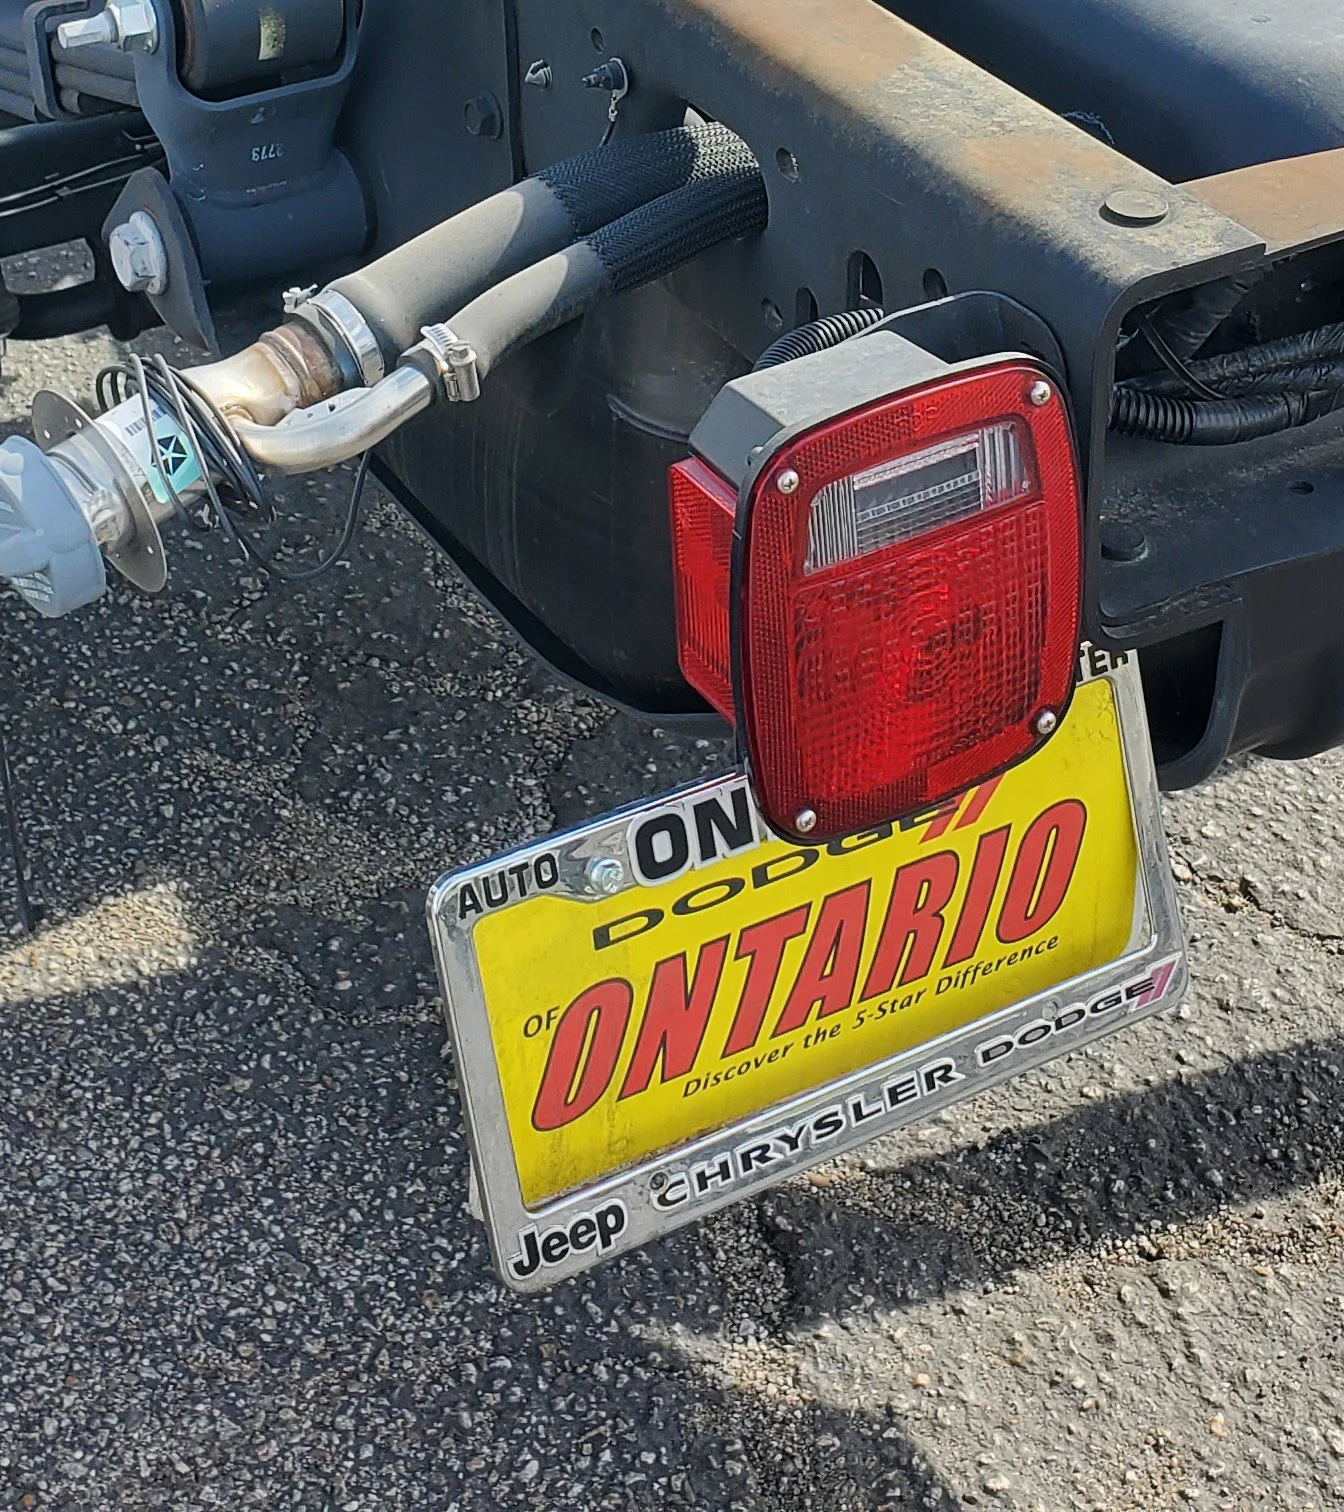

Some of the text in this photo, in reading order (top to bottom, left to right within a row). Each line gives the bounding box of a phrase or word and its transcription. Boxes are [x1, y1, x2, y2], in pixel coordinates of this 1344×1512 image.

[459, 853, 559, 920] AUTO
[522, 798, 1089, 1132] OF ONTARIO
[512, 978, 1157, 1279] Jeep CHRYSLER DODGE
[682, 934, 1059, 1099] Discover the 5-Star Difference
